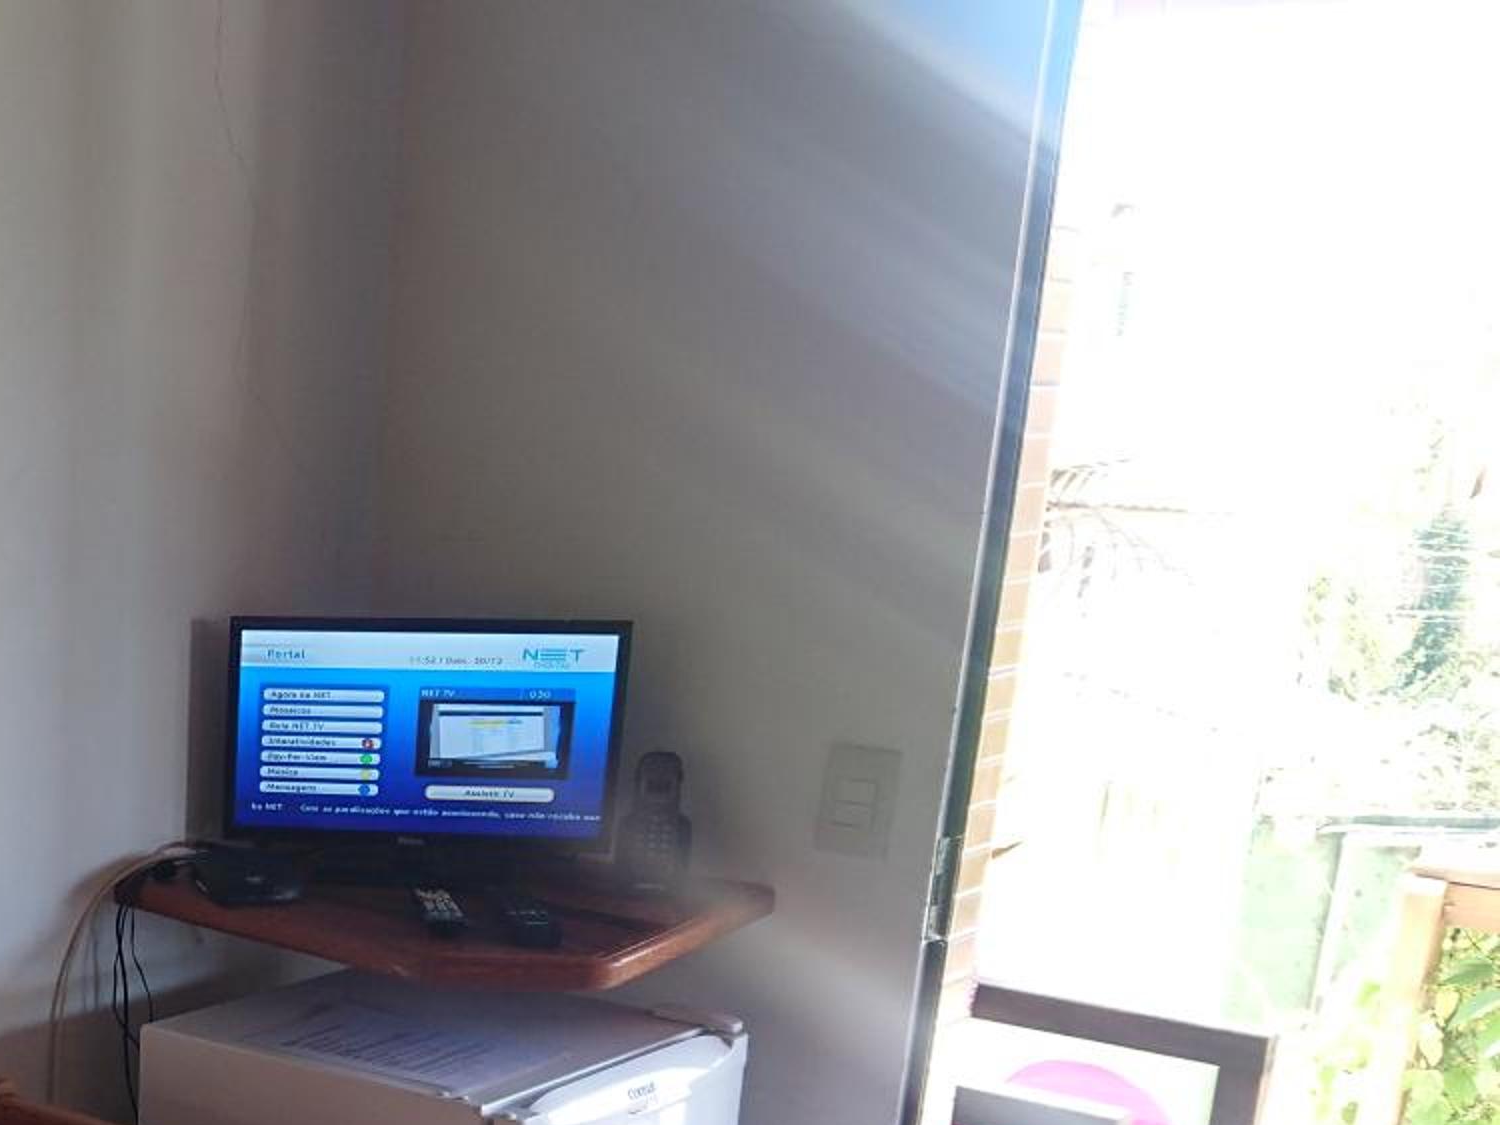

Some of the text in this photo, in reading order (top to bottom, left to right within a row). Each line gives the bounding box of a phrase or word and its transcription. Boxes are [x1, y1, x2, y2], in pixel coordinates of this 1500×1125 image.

[266, 649, 306, 660] Portal
[522, 648, 586, 662] NET
[314, 692, 332, 700] NET
[421, 688, 440, 698] NET
[503, 790, 515, 799] TV
